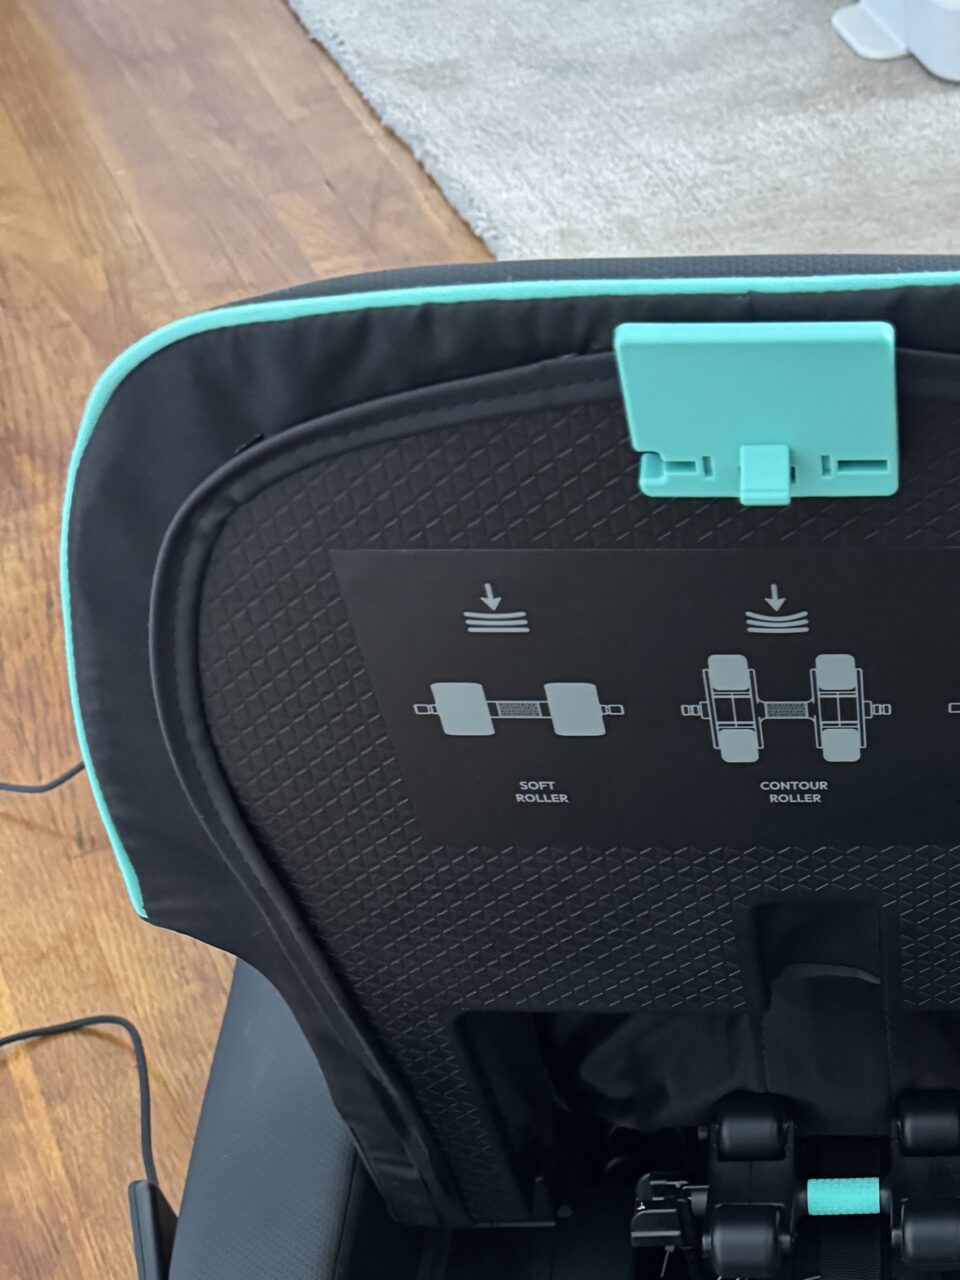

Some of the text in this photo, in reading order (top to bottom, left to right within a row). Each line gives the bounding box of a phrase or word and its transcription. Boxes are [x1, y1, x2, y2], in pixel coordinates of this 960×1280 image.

[519, 780, 555, 791] SOFT
[759, 780, 828, 791] CONTOUR
[515, 793, 569, 803] ROLLER
[769, 793, 822, 803] ROLLER
